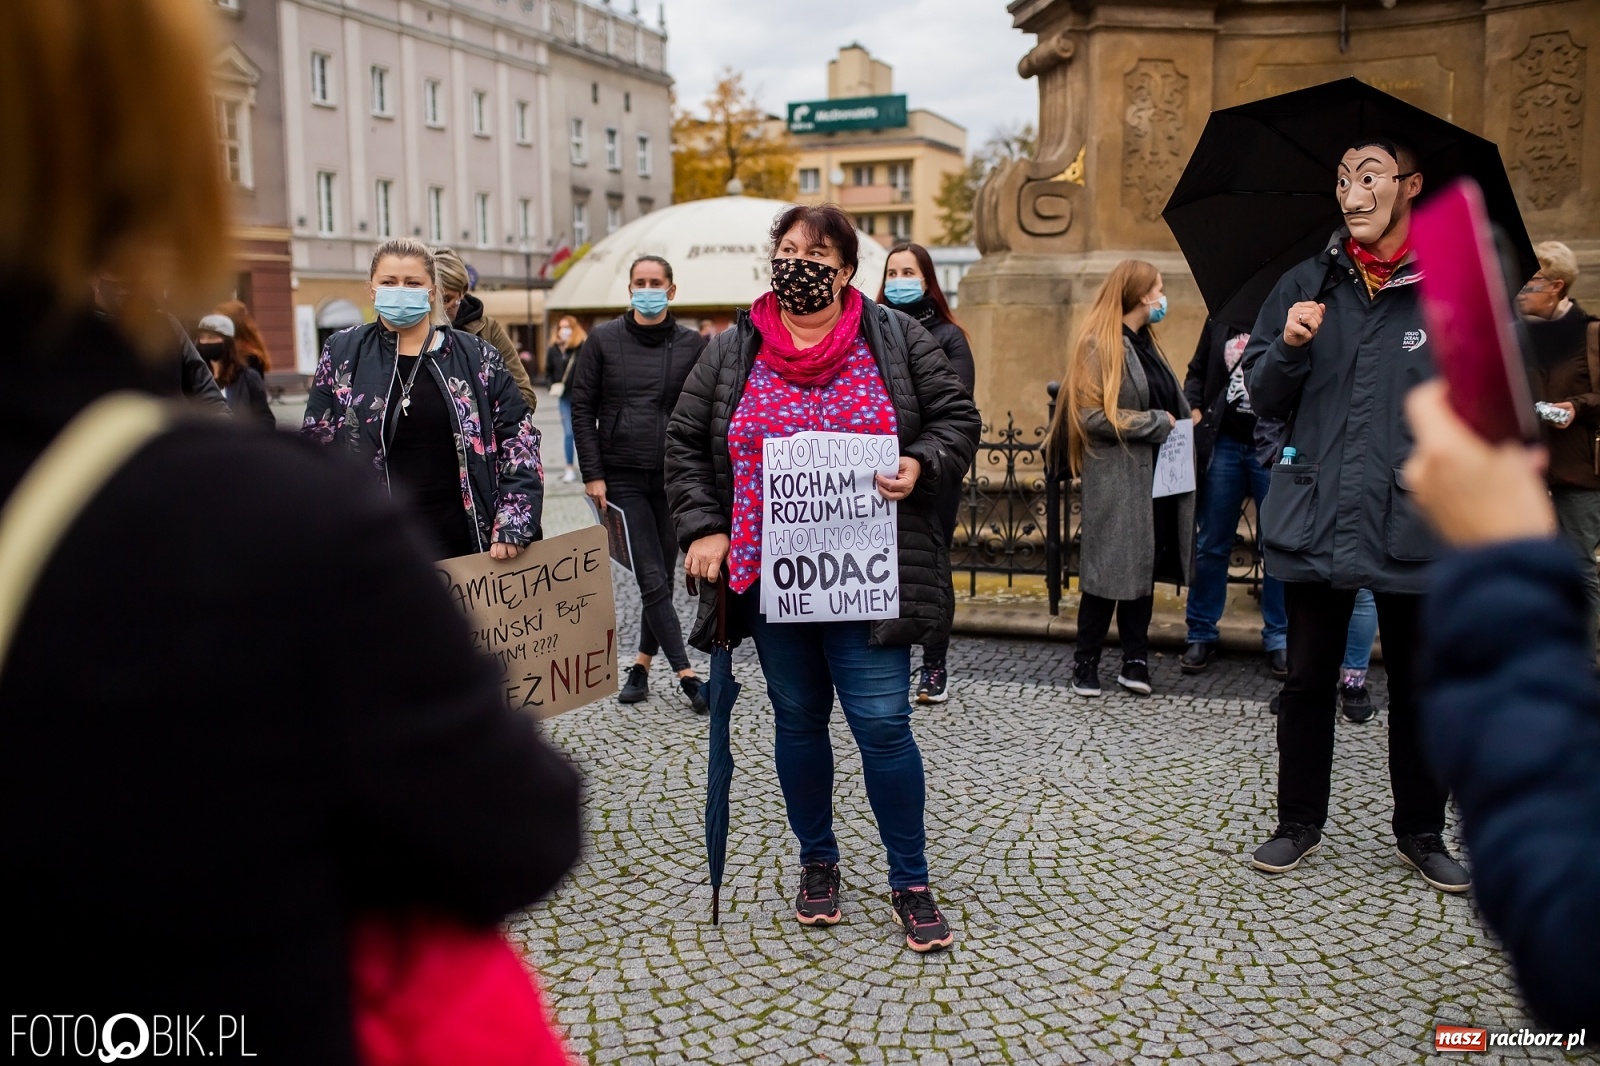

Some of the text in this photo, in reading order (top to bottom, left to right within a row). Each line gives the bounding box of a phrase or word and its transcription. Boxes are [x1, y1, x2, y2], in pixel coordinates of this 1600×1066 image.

[769, 469, 856, 499] KOCHAM
[770, 494, 891, 524] ROZUMIEM
[769, 521, 895, 556] WOLNOŚCI
[773, 547, 890, 591] ODDAĆ
[778, 585, 898, 618] NIE UMIEM
[533, 633, 559, 658] ????
[550, 628, 614, 702] NIE!
